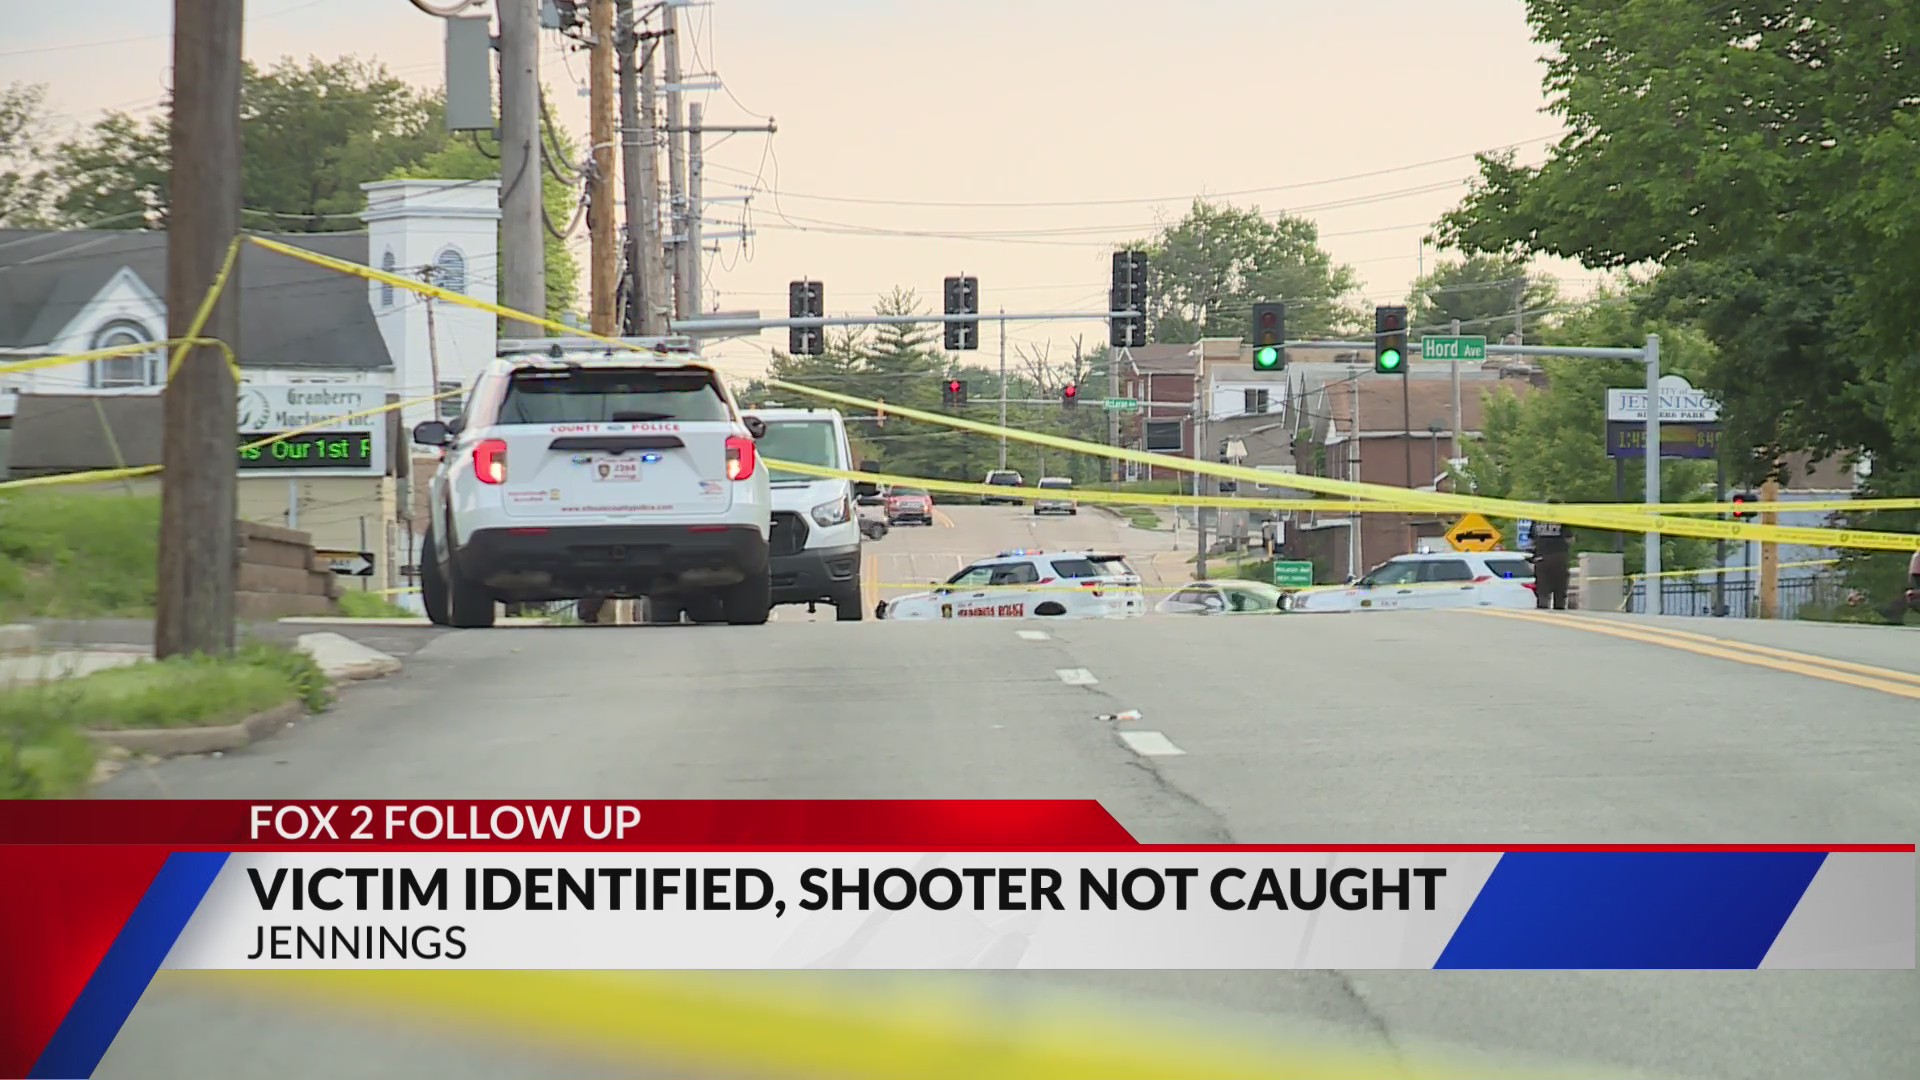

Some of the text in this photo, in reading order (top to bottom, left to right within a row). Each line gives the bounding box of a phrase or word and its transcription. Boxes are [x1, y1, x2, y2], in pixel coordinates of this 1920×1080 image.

[1426, 340, 1481, 357] Hord Ave
[287, 388, 362, 406] Granberry
[551, 423, 680, 433] COUNTY POLICE
[272, 440, 311, 460] Our
[315, 438, 350, 459] 1st
